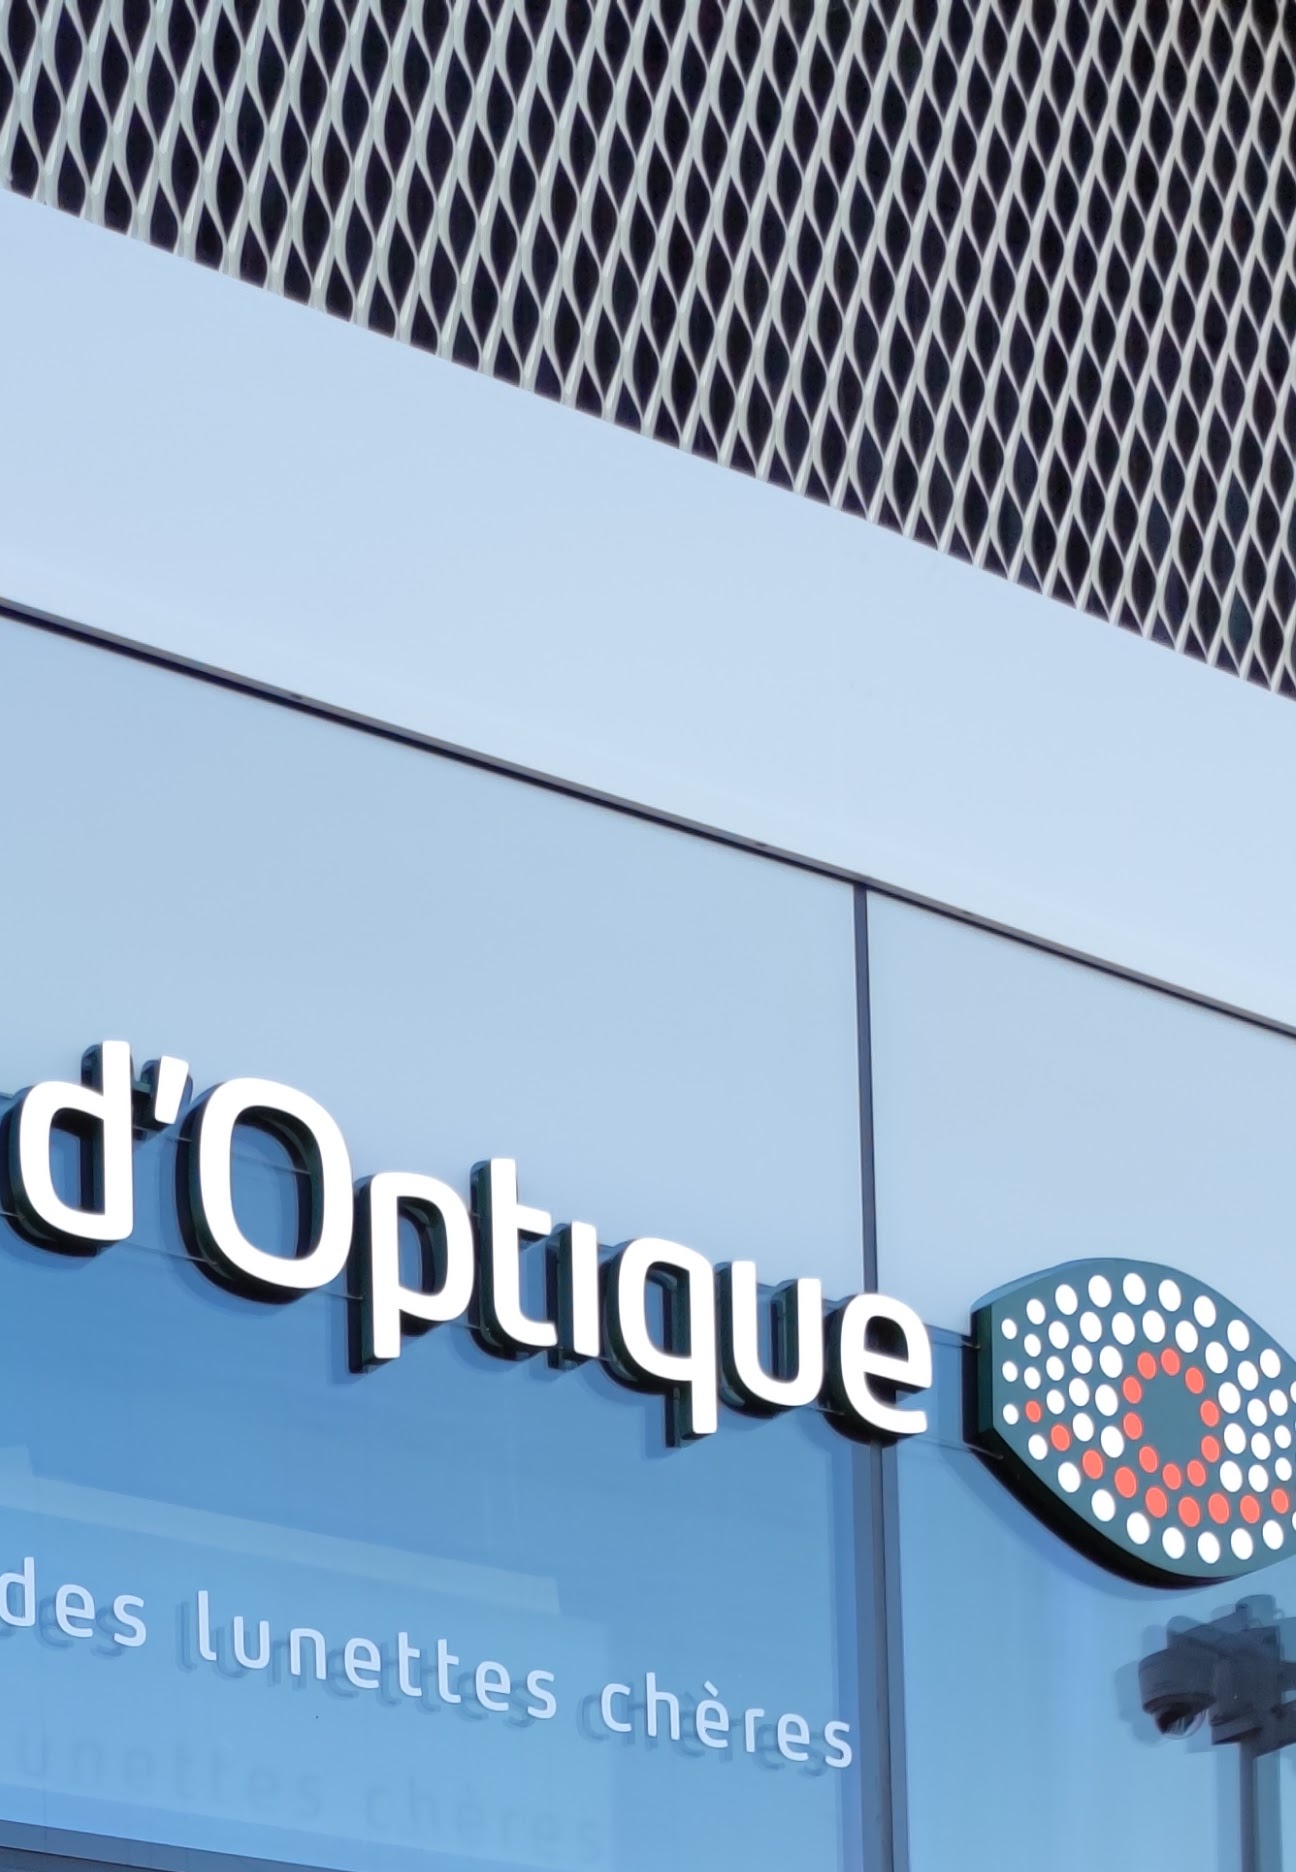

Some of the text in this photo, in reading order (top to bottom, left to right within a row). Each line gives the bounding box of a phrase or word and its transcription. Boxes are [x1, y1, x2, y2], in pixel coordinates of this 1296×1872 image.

[16, 1040, 933, 1436] d'Optique
[197, 1589, 558, 1722] lunettes
[600, 1671, 854, 1770] chères
